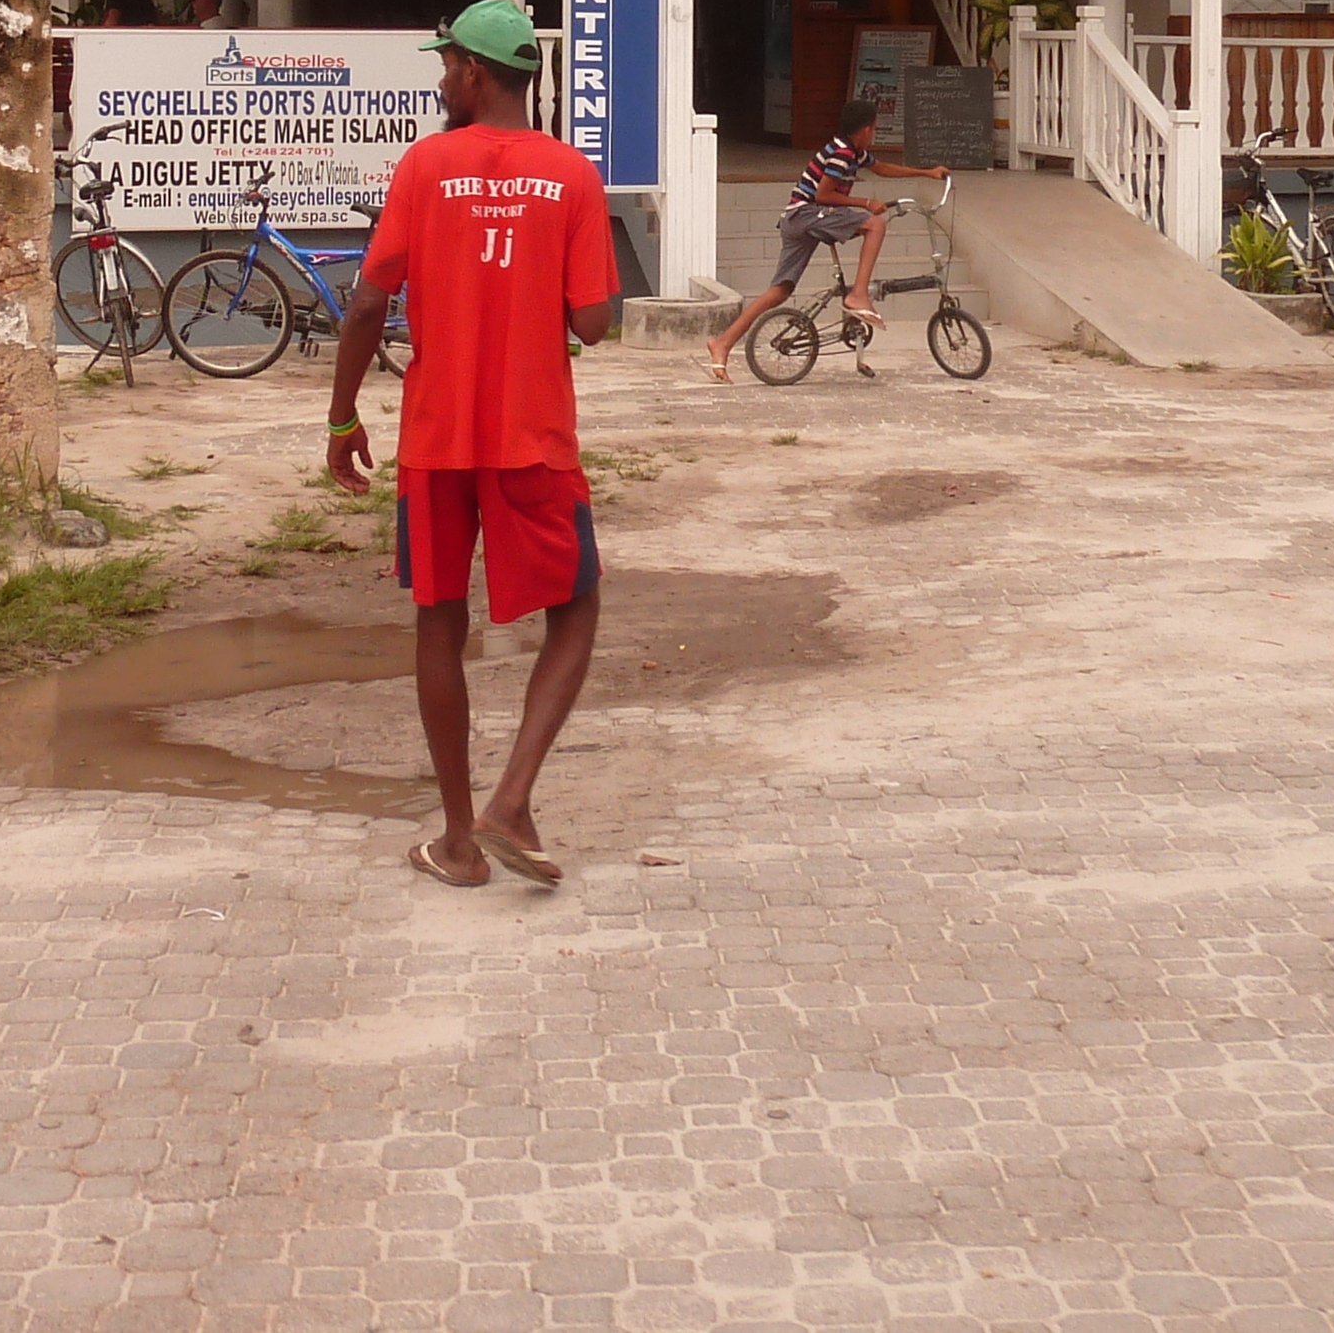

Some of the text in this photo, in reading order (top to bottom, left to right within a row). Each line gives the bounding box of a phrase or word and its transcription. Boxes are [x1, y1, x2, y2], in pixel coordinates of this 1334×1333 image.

[219, 49, 345, 69] Seychelles
[210, 69, 343, 84] Ports Authority
[98, 90, 442, 116] SEYCHELLES PORTS AUTHORITY
[125, 118, 418, 146] HEAD OFFICE MAHE ISLAND
[241, 147, 277, 157] (+248
[280, 147, 303, 156] 224
[306, 147, 335, 157] 701)
[131, 161, 198, 186] DIGUE
[205, 160, 273, 186] JETTY
[281, 161, 287, 186] P
[289, 161, 296, 186] O
[297, 161, 314, 186] Box
[315, 161, 325, 185] 47
[383, 160, 401, 170] Te
[124, 188, 172, 207] E-mail
[440, 177, 565, 202] THE YOUTH
[194, 210, 226, 224] Web
